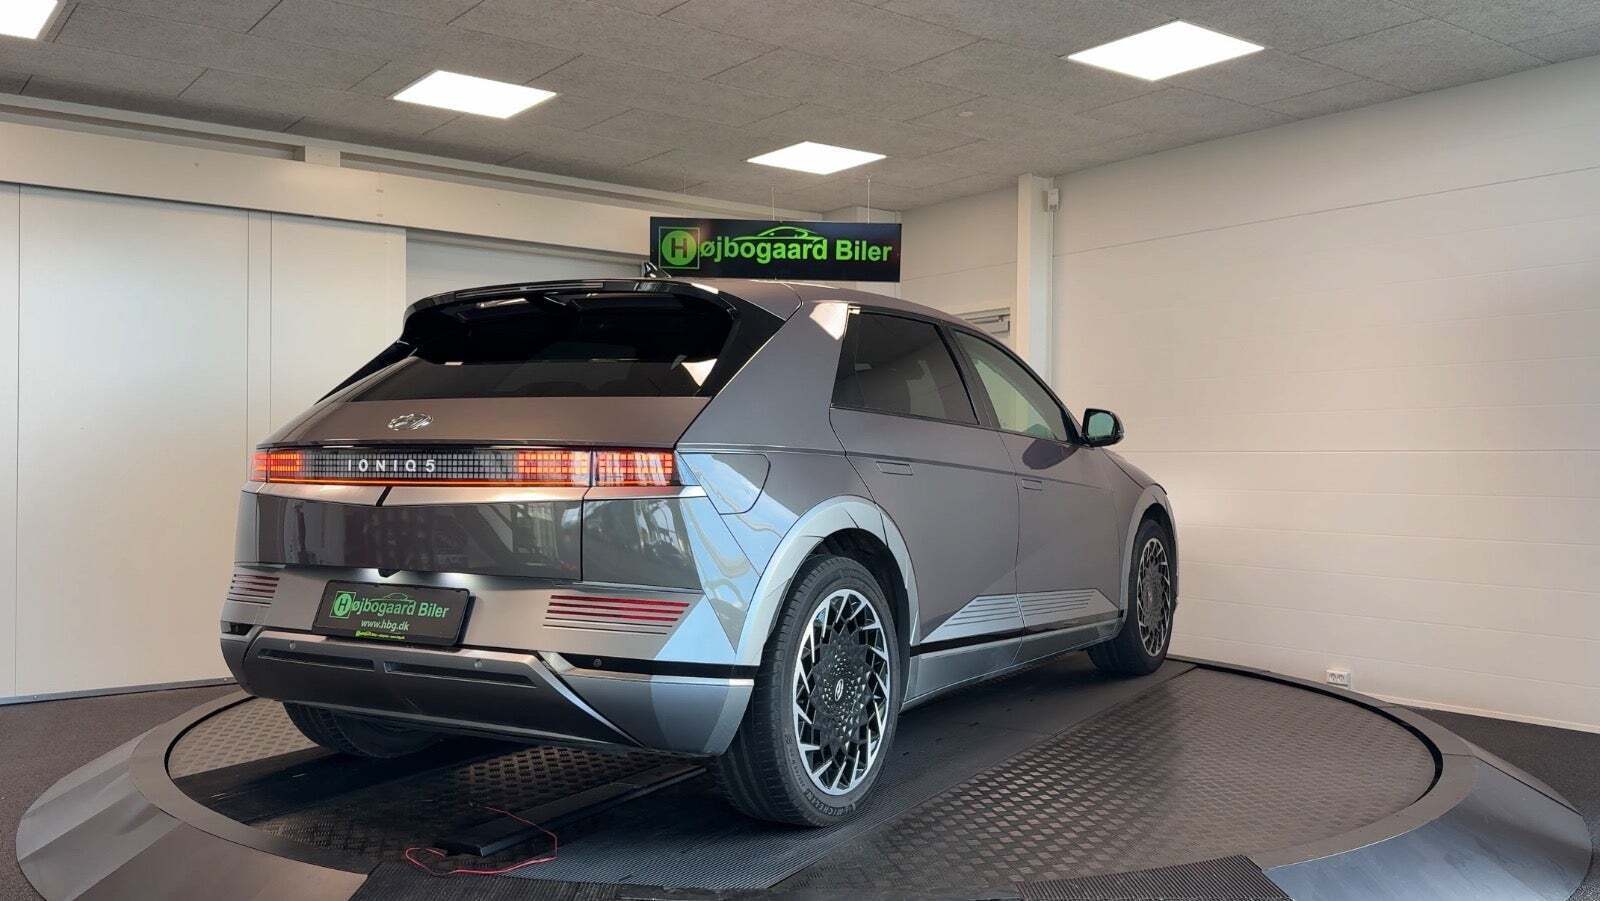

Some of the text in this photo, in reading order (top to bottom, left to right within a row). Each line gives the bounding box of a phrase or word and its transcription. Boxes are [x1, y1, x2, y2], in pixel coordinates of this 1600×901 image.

[670, 235, 893, 264] Højbogaard Biler
[337, 595, 450, 618] Højbogaard Biler
[360, 619, 410, 633] www.hbg.dk
